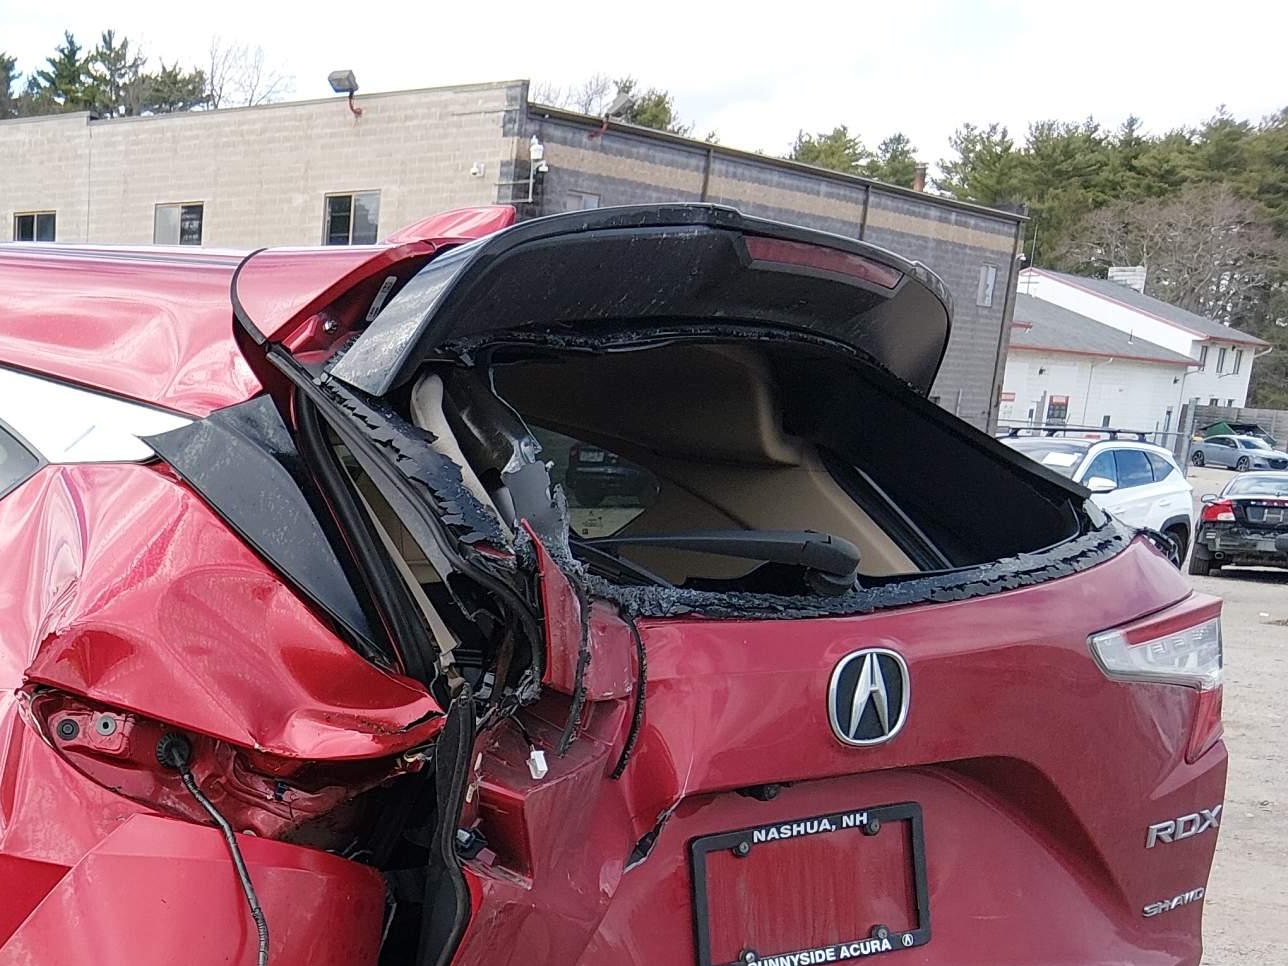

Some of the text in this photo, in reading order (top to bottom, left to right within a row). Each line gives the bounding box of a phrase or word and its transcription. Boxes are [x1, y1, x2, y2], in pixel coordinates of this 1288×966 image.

[753, 812, 868, 843] NASHUA, NH
[1145, 804, 1223, 849] RDX
[840, 938, 892, 961] ACURA
